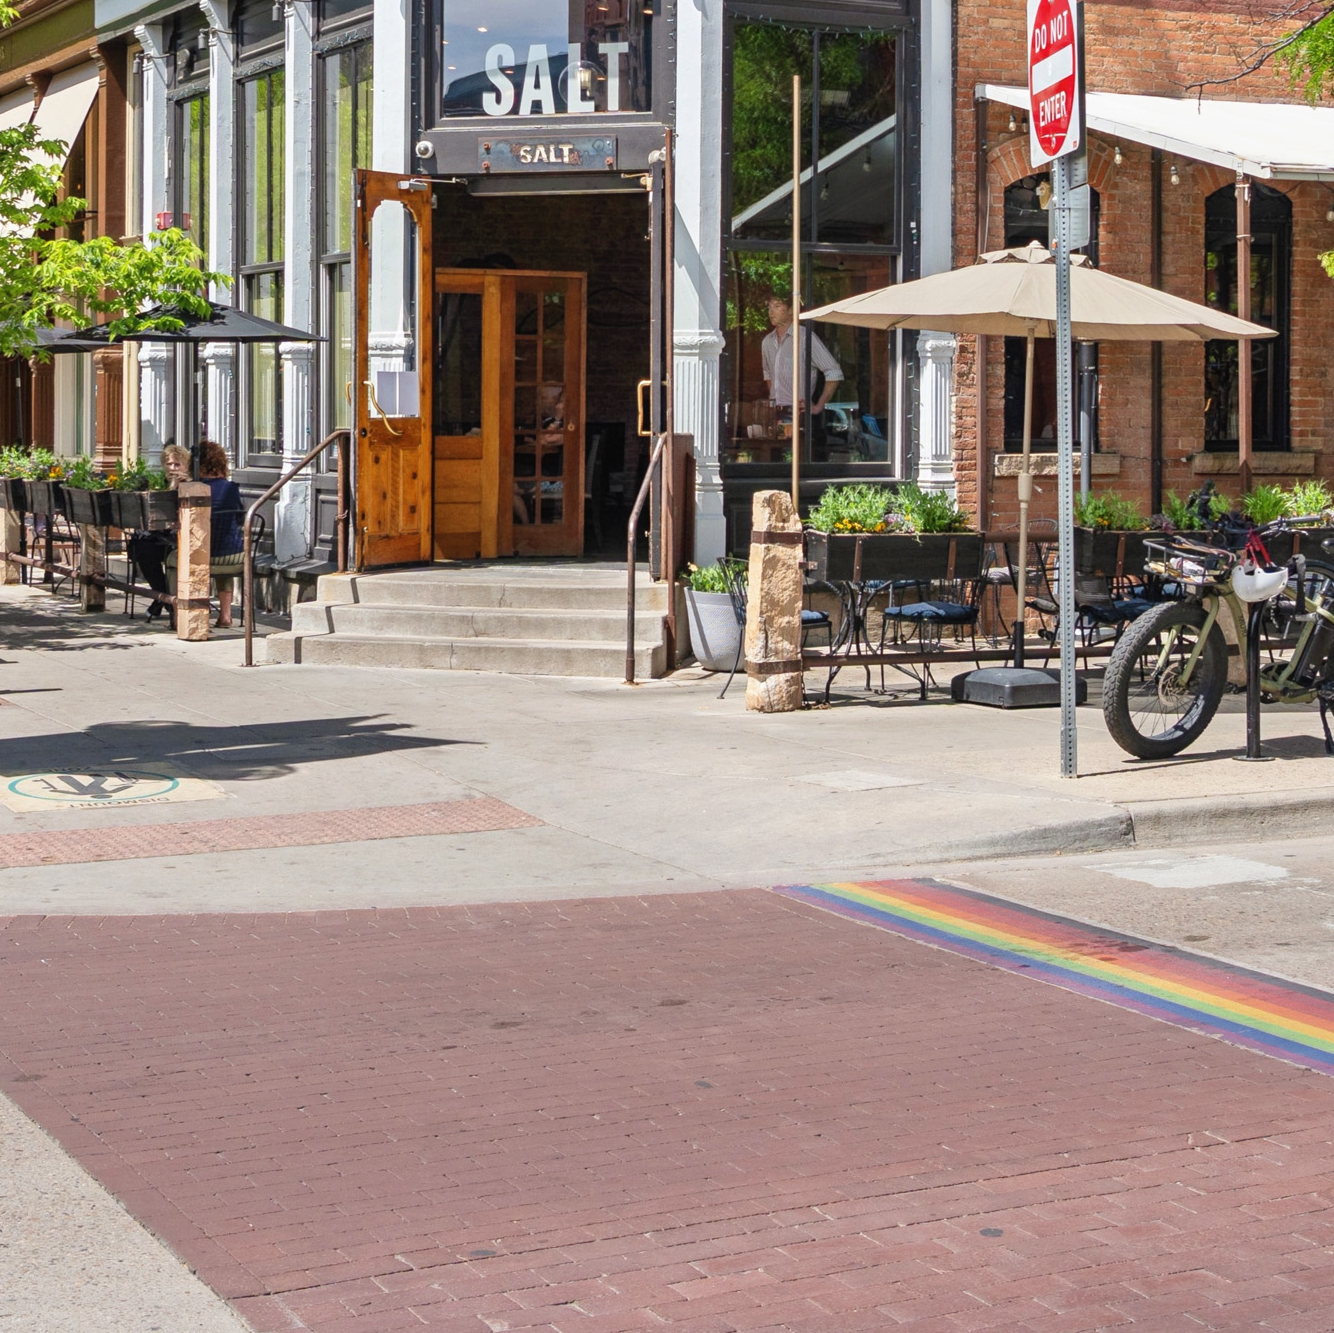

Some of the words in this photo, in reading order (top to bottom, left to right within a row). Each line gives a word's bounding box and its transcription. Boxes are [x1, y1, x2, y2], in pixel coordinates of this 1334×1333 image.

[1034, 26, 1047, 54] DO
[1050, 10, 1068, 44] NOT
[482, 42, 629, 117] SALT
[1039, 90, 1066, 128] ENTER
[519, 144, 573, 164] SALT
[69, 797, 170, 808] DISMOUNT
